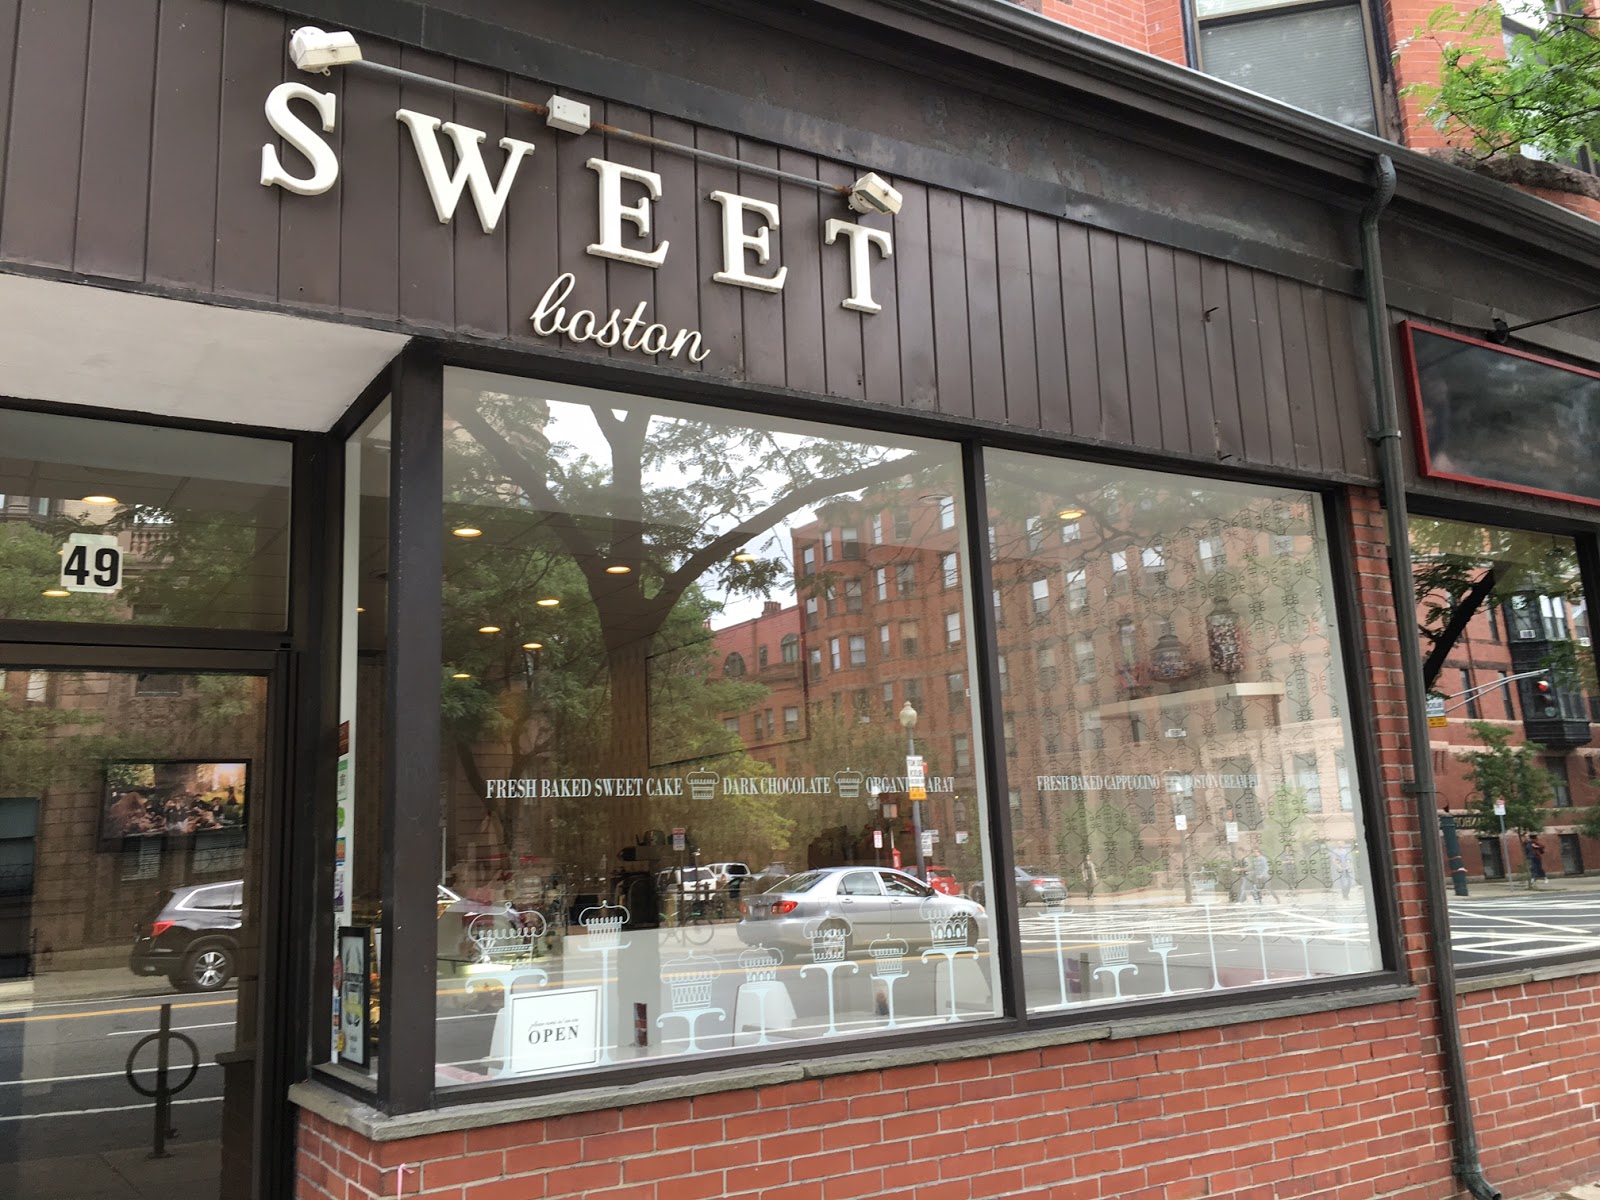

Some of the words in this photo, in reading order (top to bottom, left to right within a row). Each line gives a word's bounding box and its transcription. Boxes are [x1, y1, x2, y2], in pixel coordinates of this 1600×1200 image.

[260, 81, 894, 315] SWEET
[530, 272, 711, 364] boston
[63, 545, 120, 587] 49
[485, 779, 537, 799] FRESH
[540, 778, 592, 798] BAKED
[594, 778, 643, 797] SWEET
[646, 777, 684, 796] CAKE
[723, 777, 759, 795] DARK
[760, 776, 831, 794] CHOCOLATE
[865, 776, 917, 793] ORGANI
[1036, 775, 1069, 791] FRESH
[1070, 774, 1103, 790] BAKED
[1104, 774, 1160, 790] CAPPUCCINO
[528, 1025, 579, 1044] OPEN
